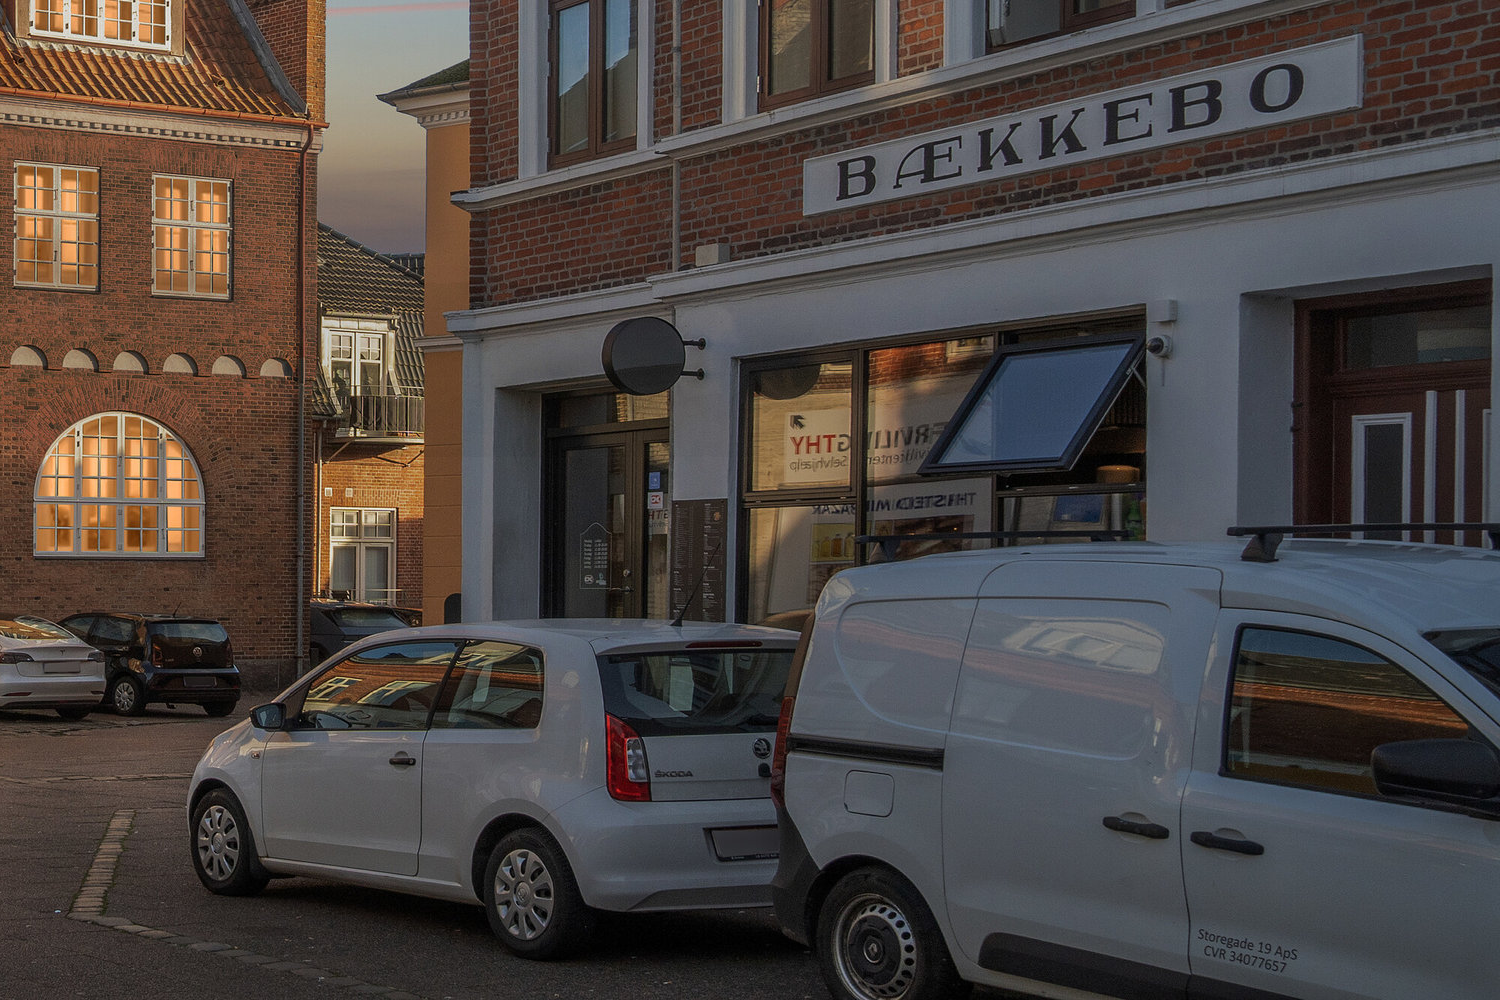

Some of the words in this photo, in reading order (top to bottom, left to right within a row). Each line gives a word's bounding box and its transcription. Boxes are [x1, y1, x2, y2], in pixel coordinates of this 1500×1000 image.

[836, 63, 1304, 201] BÆKKEBO
[654, 769, 694, 778] ŠKODA
[1197, 928, 1255, 951] Storegade
[1258, 942, 1272, 955] 19
[1274, 945, 1298, 960] ApS
[1203, 945, 1227, 960] CVR
[1228, 950, 1287, 973] 34077657
